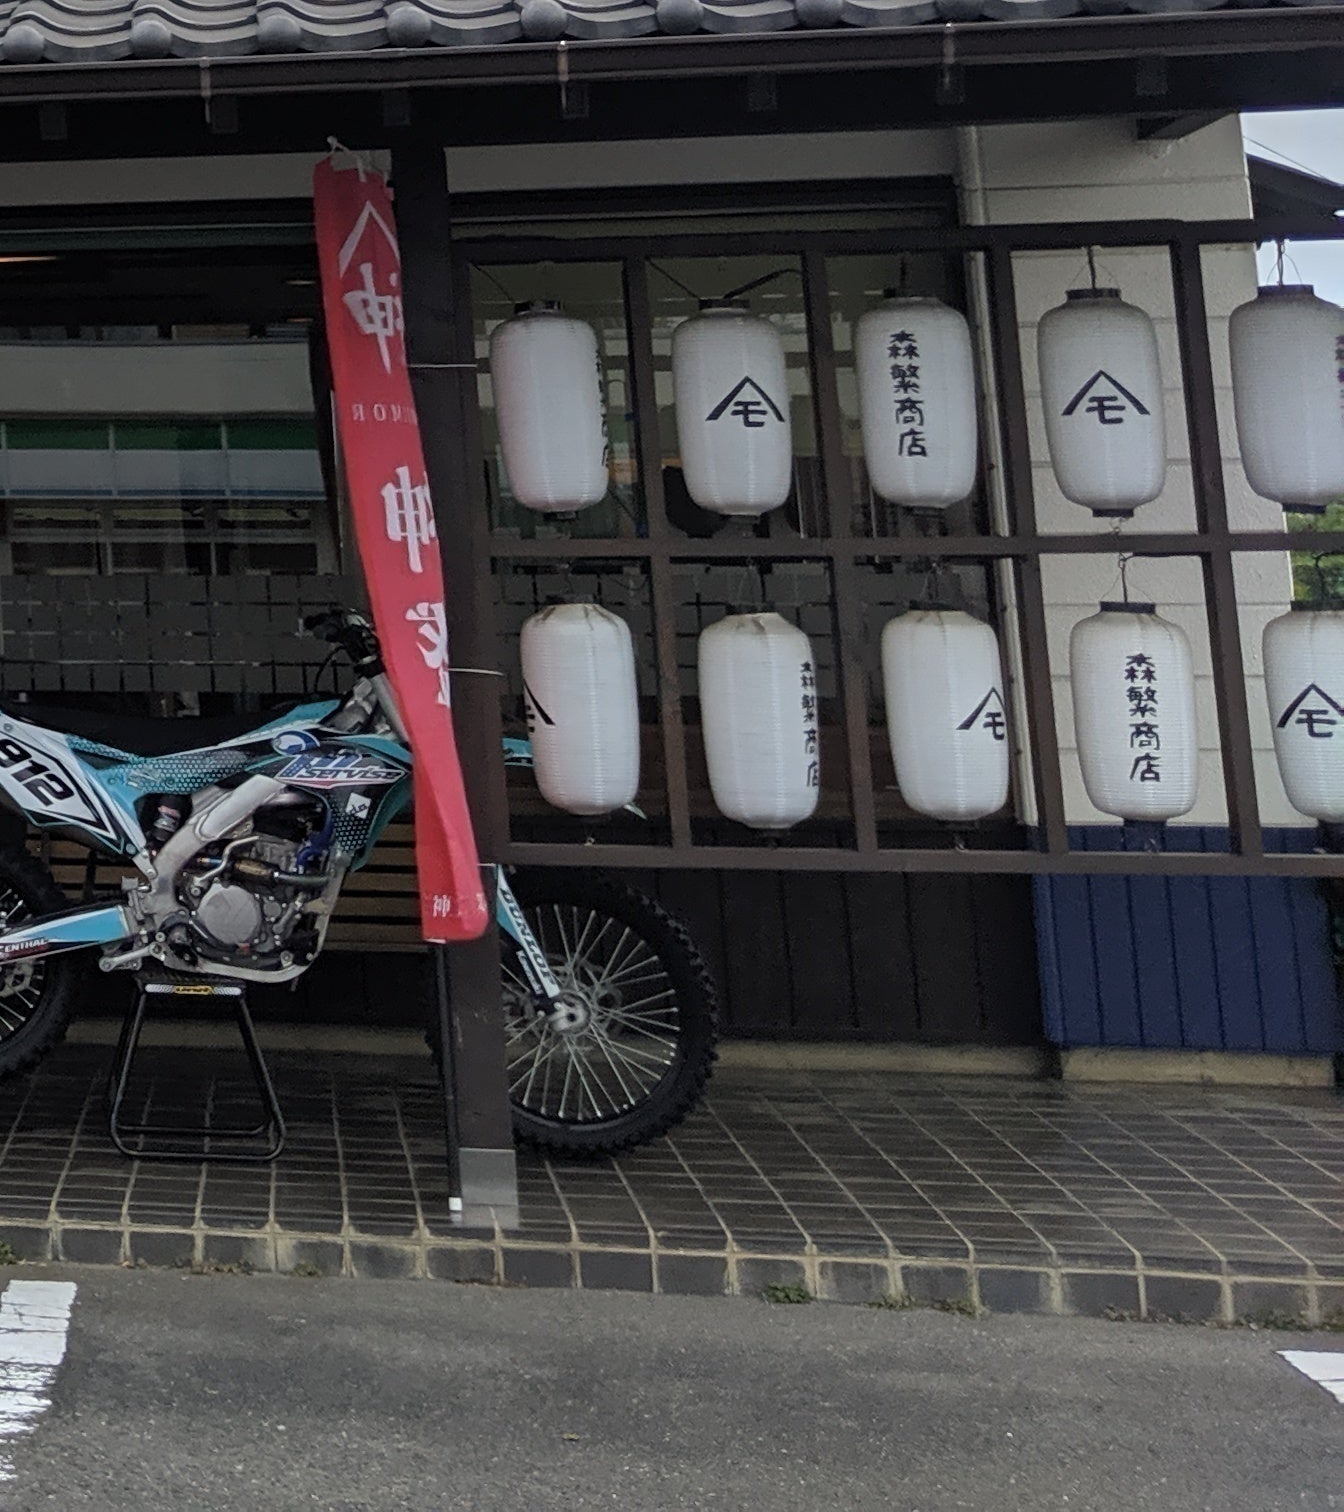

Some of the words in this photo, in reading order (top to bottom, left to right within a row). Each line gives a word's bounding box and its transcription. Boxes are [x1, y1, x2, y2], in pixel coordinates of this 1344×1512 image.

[886, 329, 929, 458] 森繁商店
[1123, 652, 1162, 783] 森繁商店
[499, 887, 557, 986] DUNLOP
